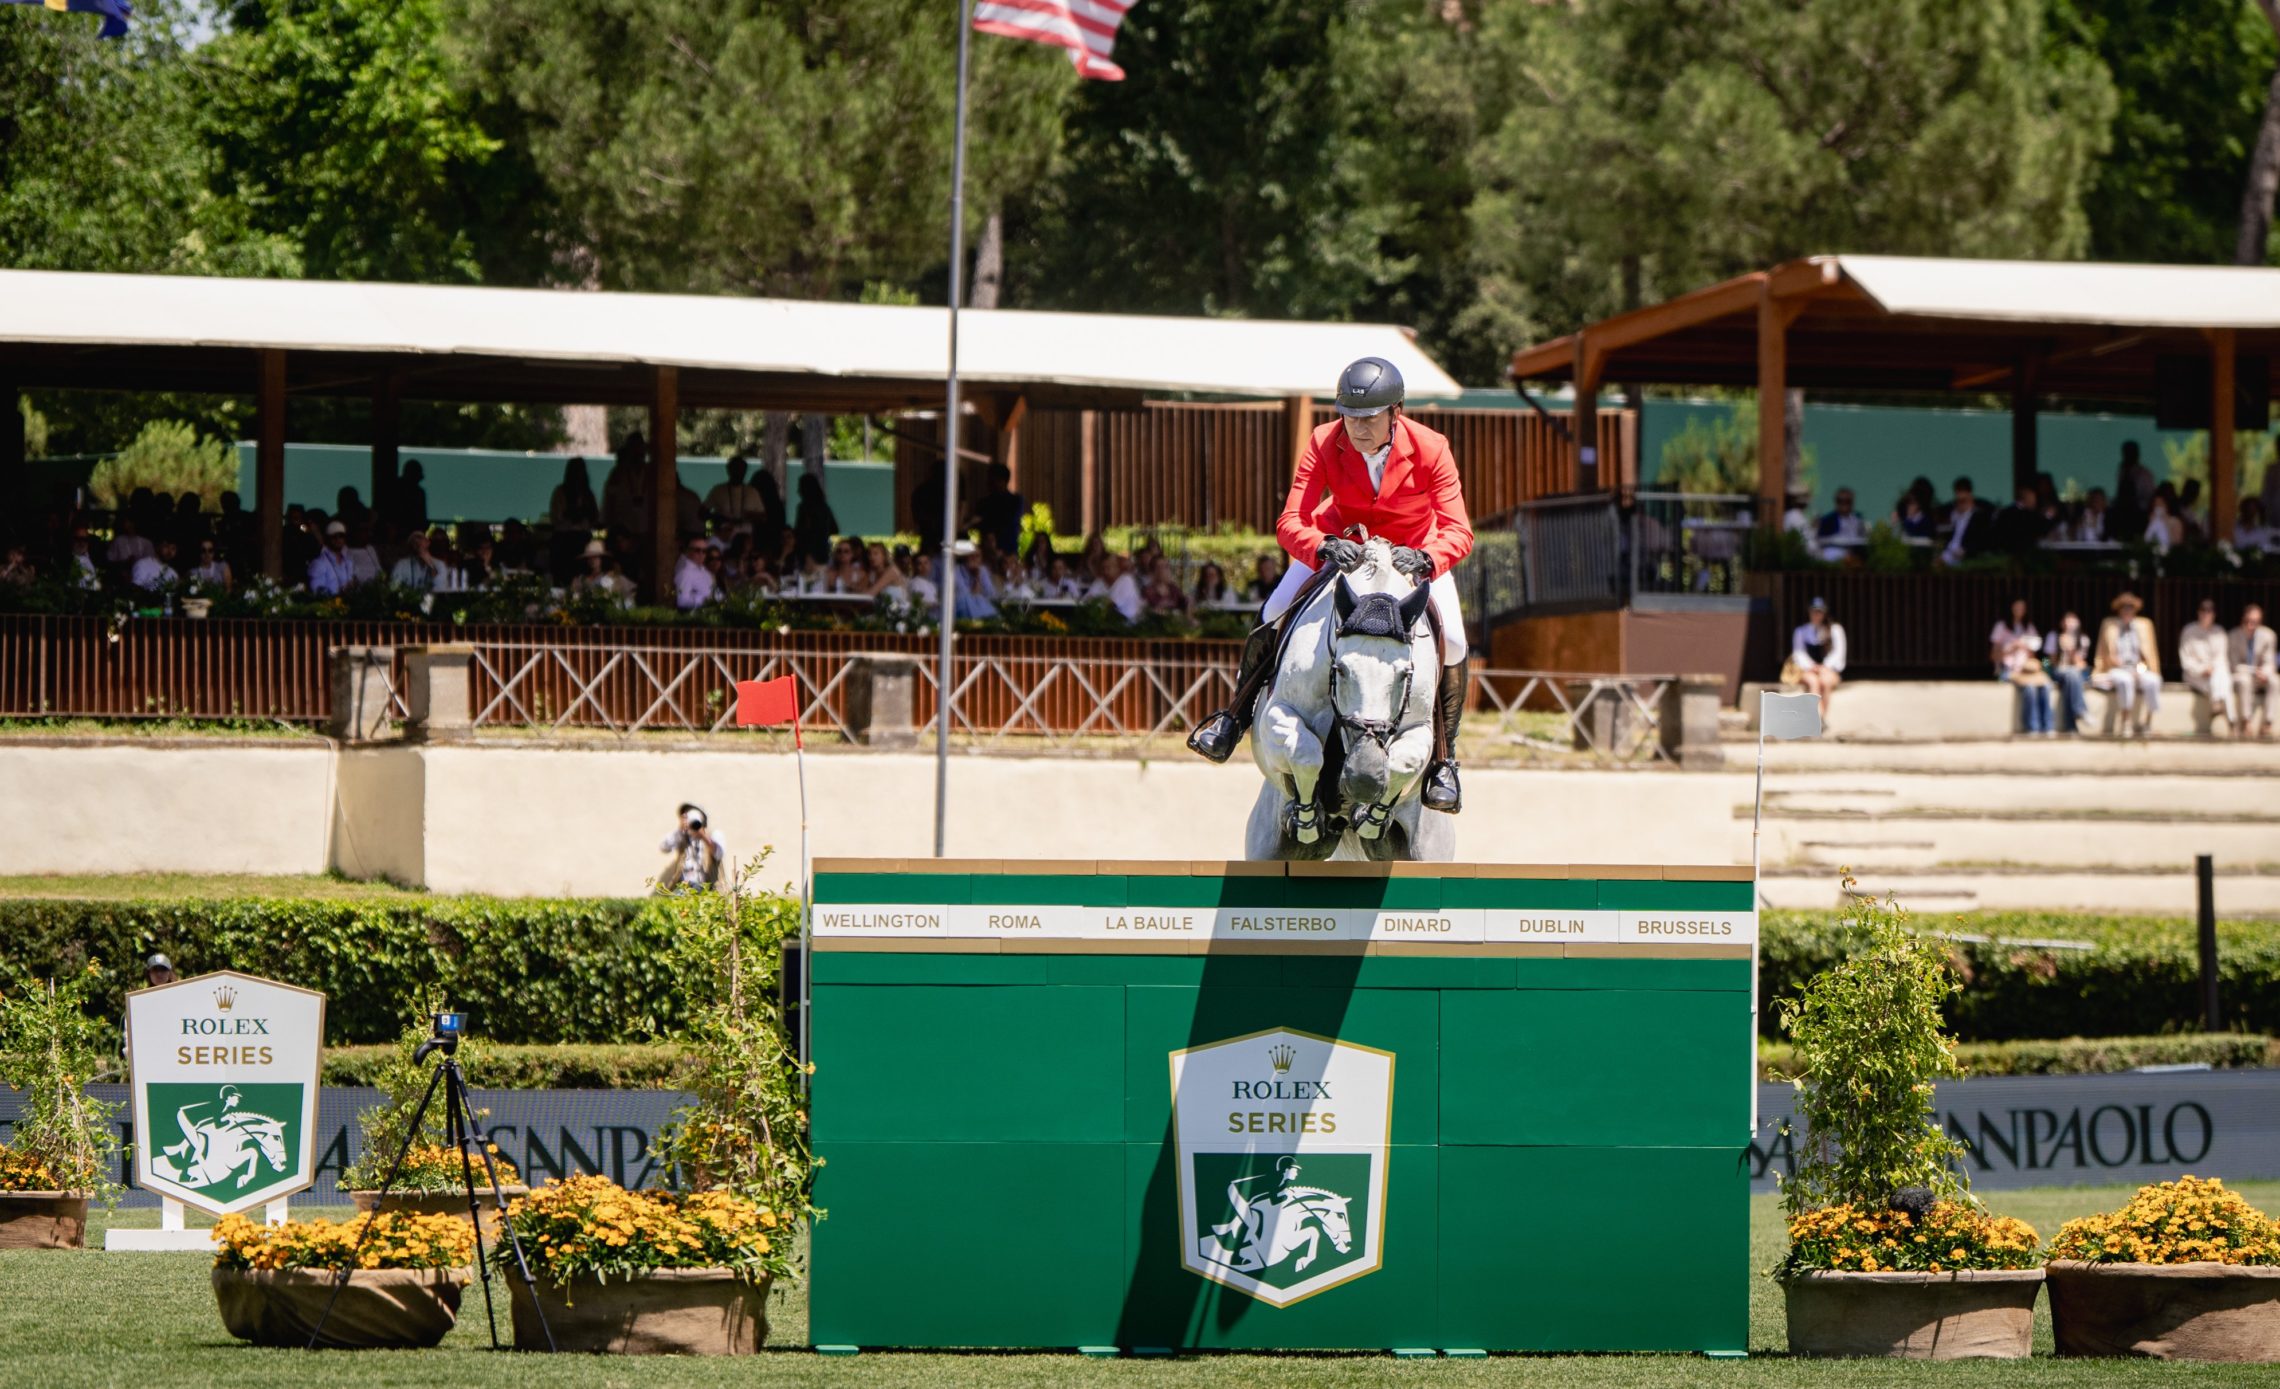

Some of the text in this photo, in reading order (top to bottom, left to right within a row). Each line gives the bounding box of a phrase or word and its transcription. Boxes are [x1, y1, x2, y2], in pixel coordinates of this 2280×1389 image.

[822, 913, 940, 929] WELLINGTON
[988, 914, 1042, 929] ROMA
[1105, 915, 1193, 931] LA BAULE
[1231, 916, 1337, 932] FALSTERBO
[1384, 918, 1452, 933] DINARD
[1519, 919, 1585, 934] DUBLIN
[1637, 920, 1732, 935] BRUSSELS
[180, 1017, 270, 1036] ROLEX
[177, 1045, 274, 1066] SERIES
[1231, 1081, 1333, 1100] ROLEX
[1228, 1111, 1337, 1134] SERIES
[1928, 1101, 2214, 1173] ANPAOLO
[486, 1125, 684, 1191] SANPA
